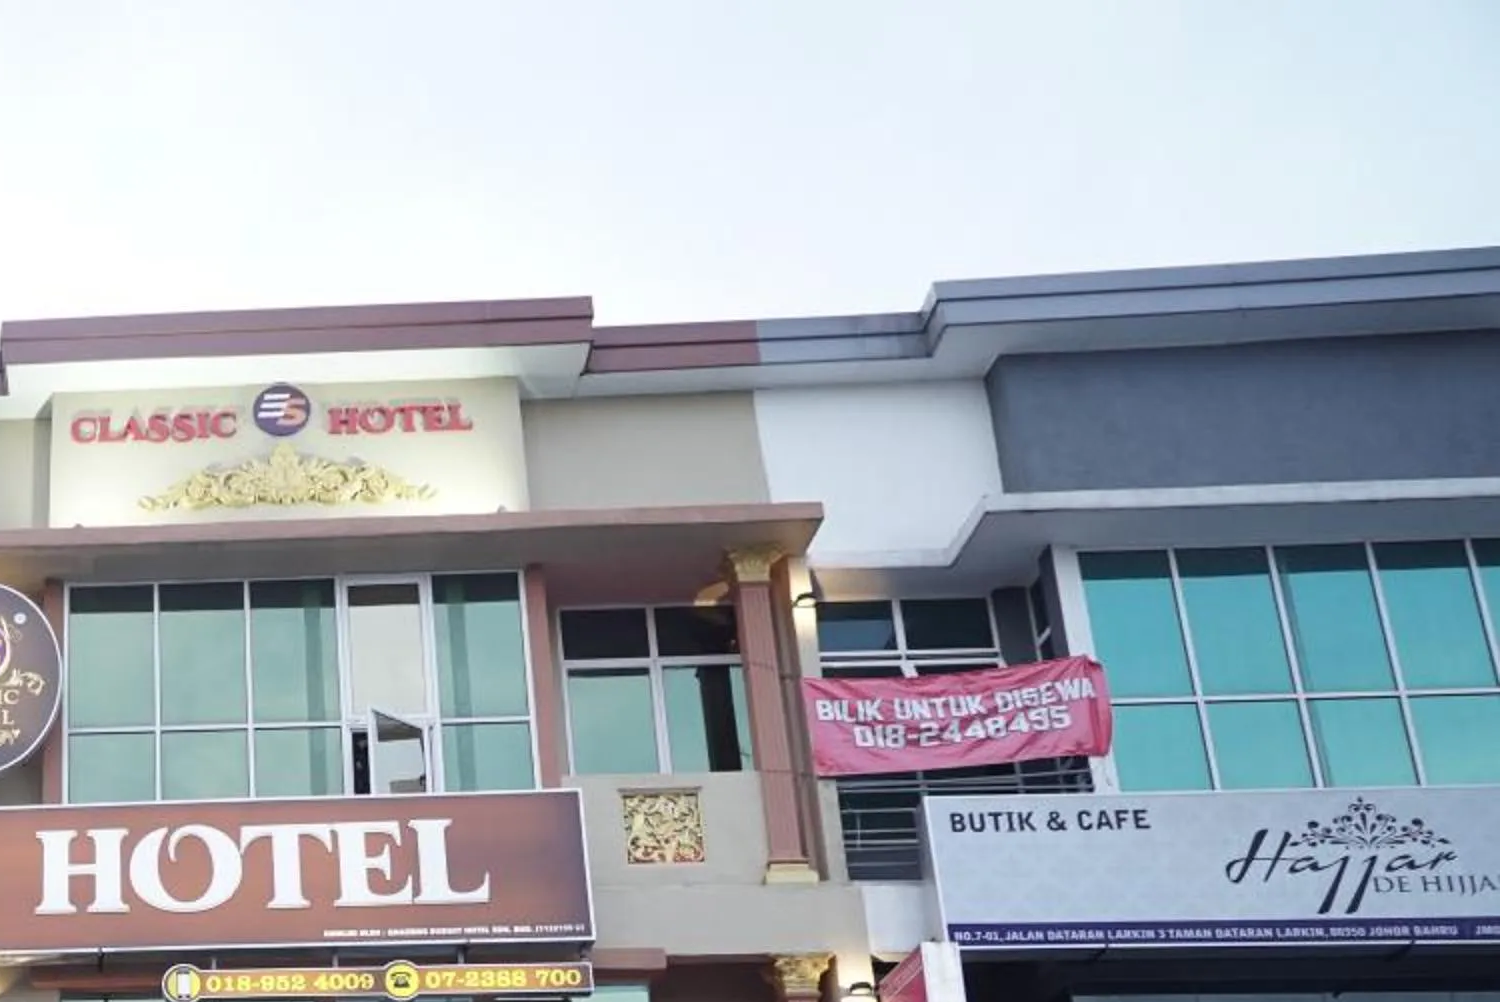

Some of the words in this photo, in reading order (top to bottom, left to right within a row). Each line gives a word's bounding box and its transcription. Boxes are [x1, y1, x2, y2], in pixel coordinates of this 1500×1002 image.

[71, 409, 238, 444] CLASSIC
[327, 403, 473, 436] HOTEL
[815, 699, 884, 722] BILIK
[893, 695, 987, 720] UNTUK
[993, 677, 1097, 713] DISEWA
[853, 704, 1073, 749] 018-2448495
[950, 811, 1037, 833] BUTIK
[1047, 811, 1067, 831] &
[1077, 808, 1152, 831] CAFE
[33, 818, 491, 915] HOTEL
[1225, 828, 1459, 915] Hajjar
[1374, 875, 1414, 894] DE
[1421, 873, 1500, 897] HIJJA
[313, 973, 375, 991] 4009
[535, 968, 583, 988] 700
